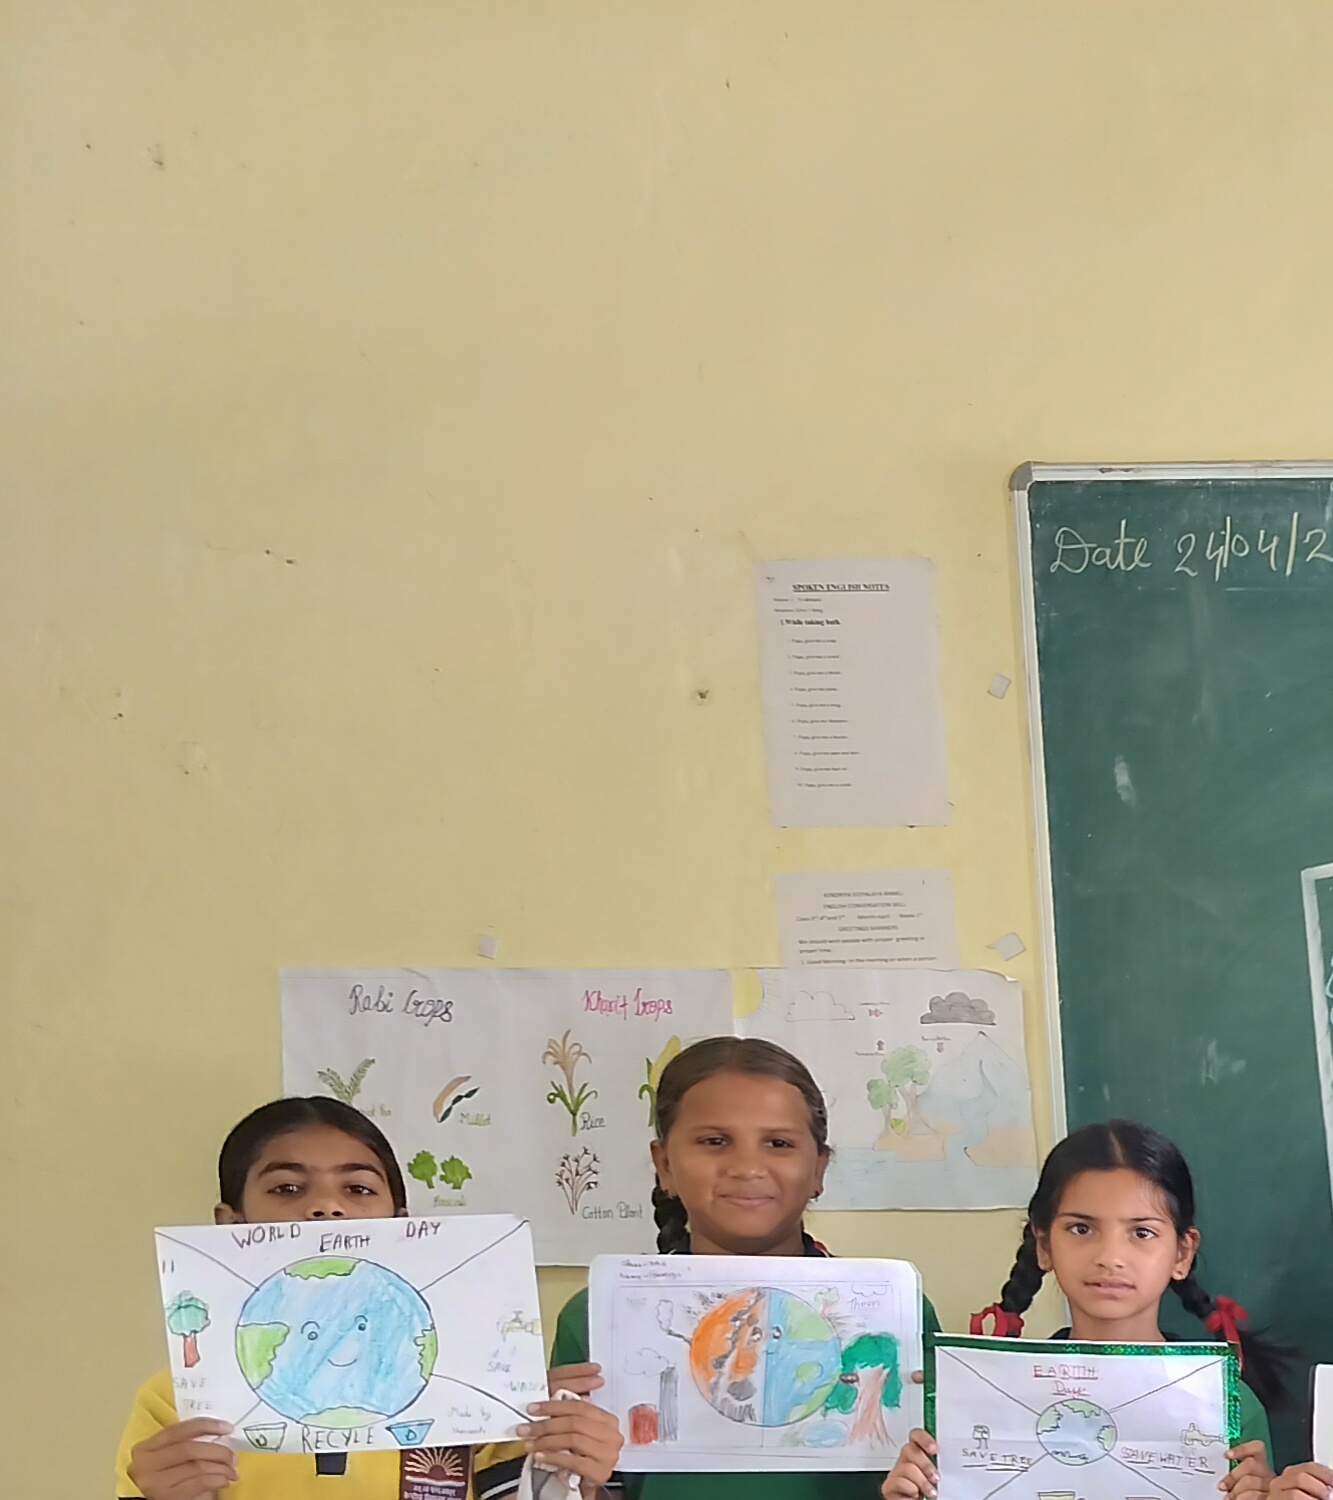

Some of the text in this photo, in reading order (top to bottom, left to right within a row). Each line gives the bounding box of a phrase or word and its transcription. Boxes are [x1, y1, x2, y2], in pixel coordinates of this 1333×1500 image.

[1050, 519, 1152, 576] Date
[349, 984, 394, 1017] Rabi
[579, 1111, 606, 1130] Rice
[231, 1220, 443, 1253] WORLD EARTH DAY
